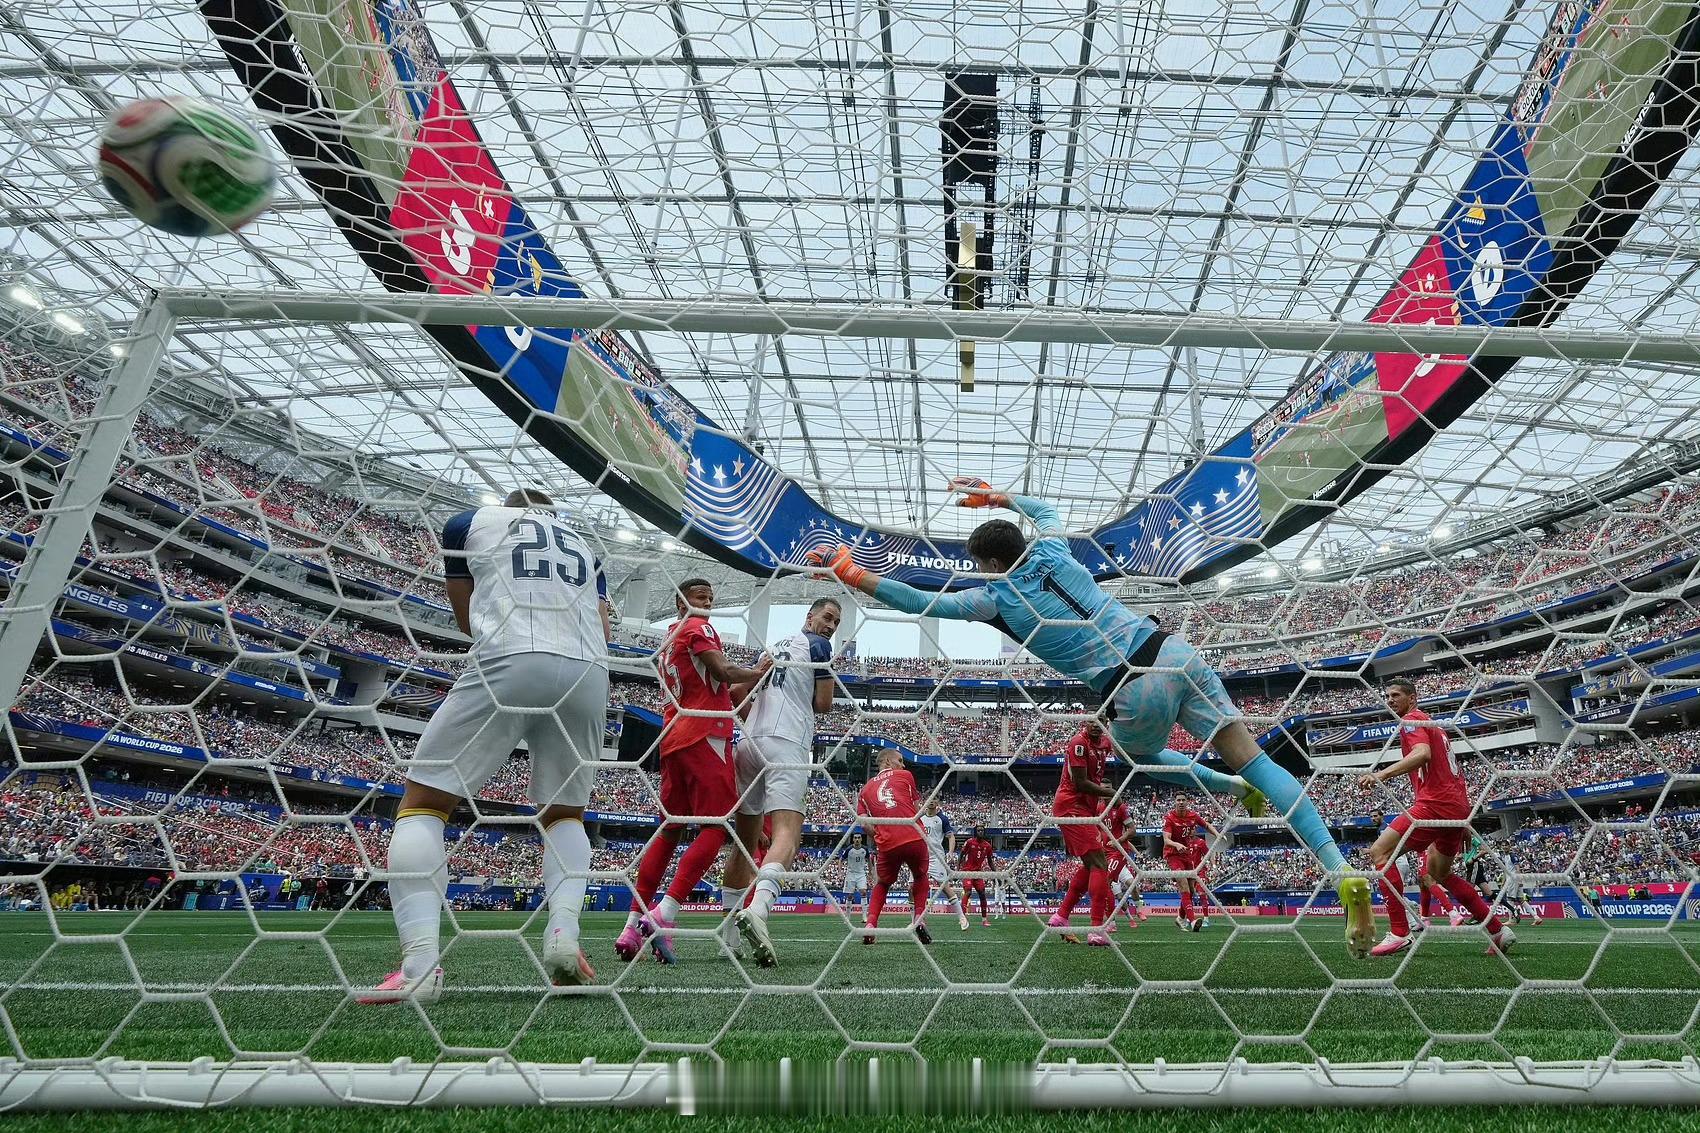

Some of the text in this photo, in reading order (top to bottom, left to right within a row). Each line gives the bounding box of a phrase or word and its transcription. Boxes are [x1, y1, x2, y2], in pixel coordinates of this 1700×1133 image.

[508, 518, 587, 588] 25
[888, 552, 918, 567] FIFA
[920, 556, 974, 571] WORLD
[65, 586, 128, 613] NGELES
[1040, 571, 1096, 620] 1
[1363, 728, 1381, 738] FIFA
[120, 736, 145, 747] WORLD
[145, 741, 160, 750] CUP
[161, 743, 183, 754] 2026
[145, 791, 166, 802] FIFA
[221, 801, 244, 812] 202
[1626, 904, 1641, 914] CUP
